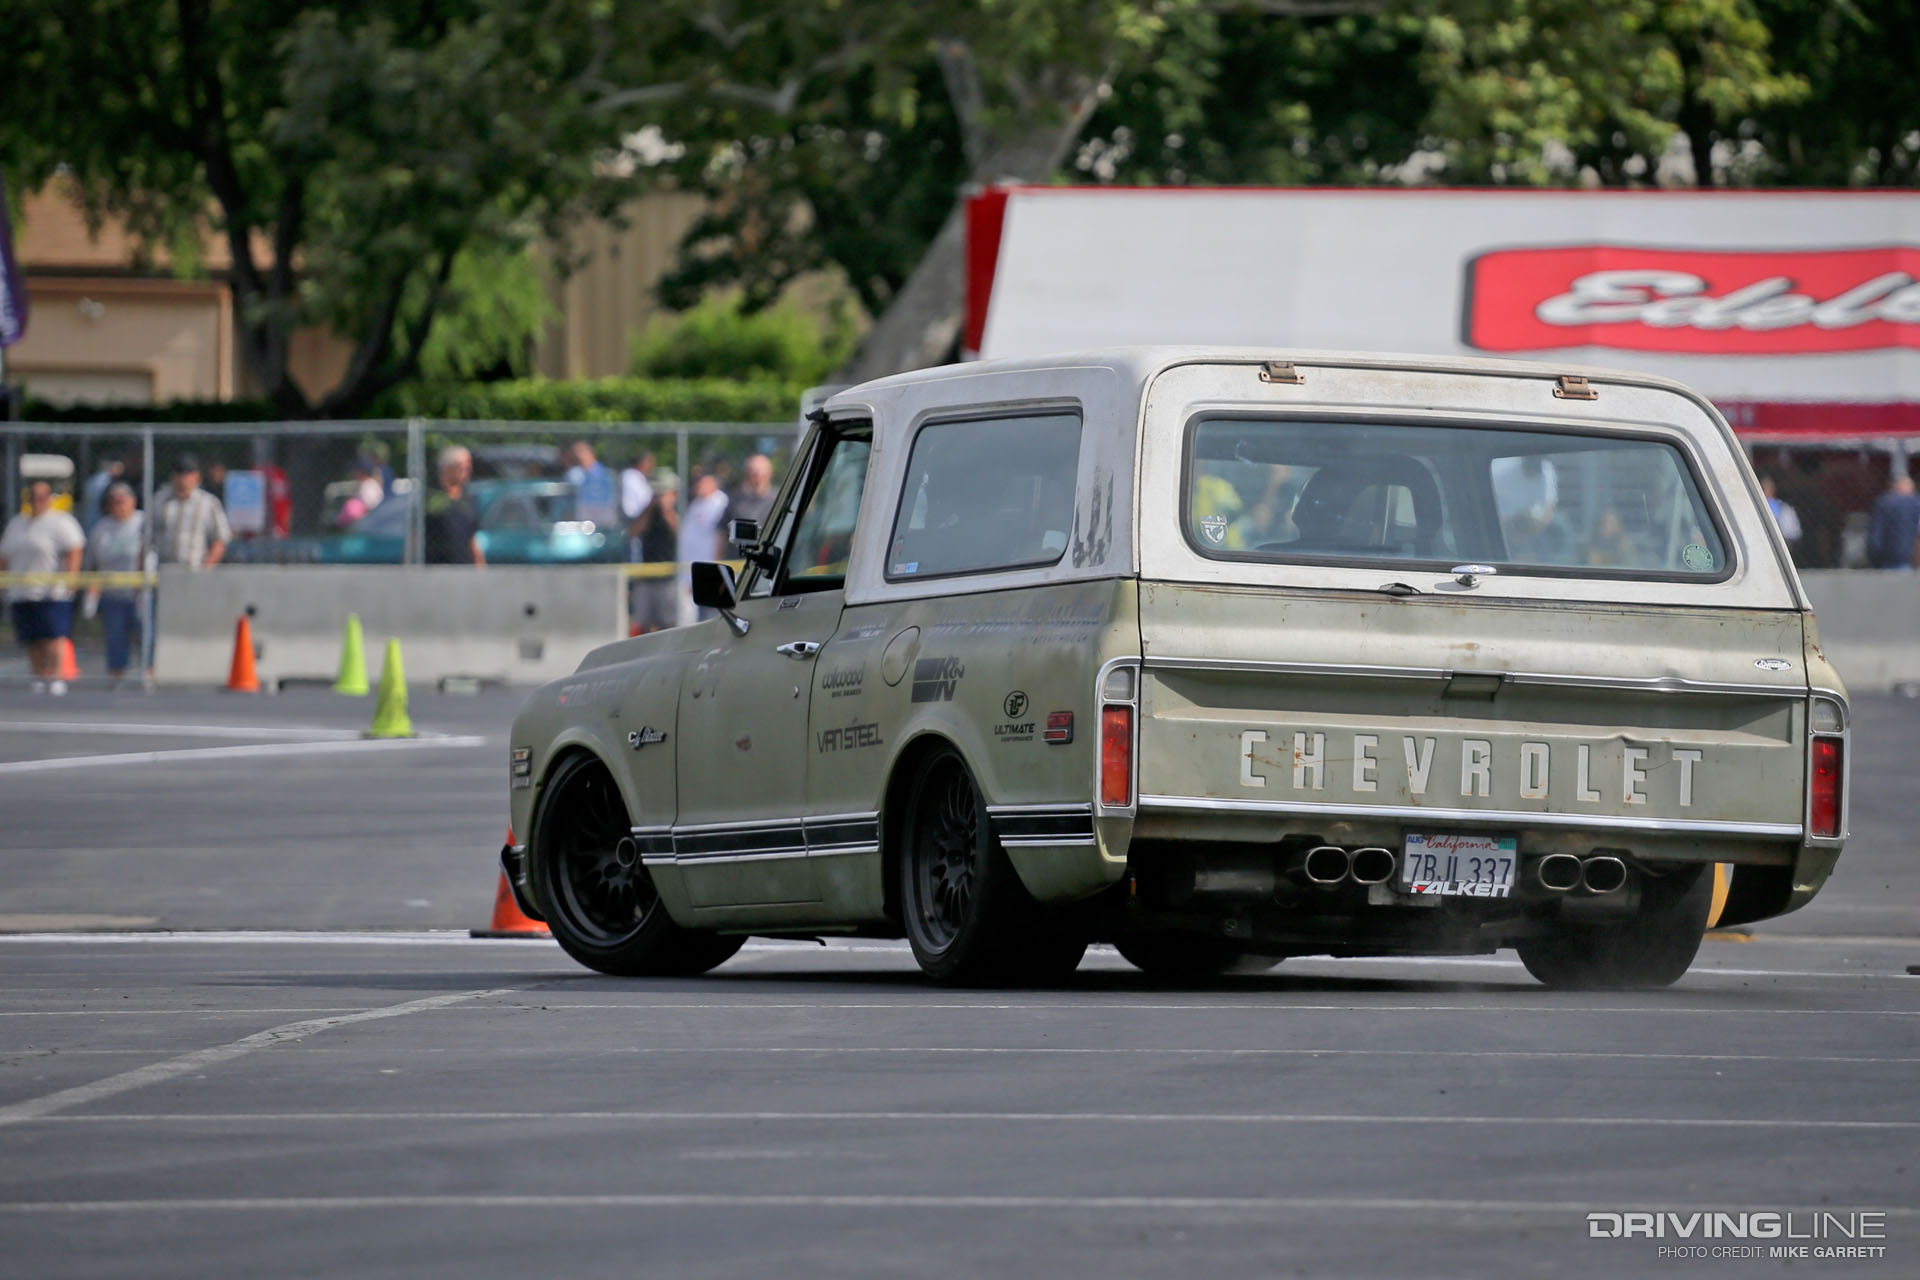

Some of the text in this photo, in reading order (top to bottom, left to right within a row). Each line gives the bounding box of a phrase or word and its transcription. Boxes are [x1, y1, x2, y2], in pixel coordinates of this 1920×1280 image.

[995, 723, 1036, 735] ULTIMATE
[1240, 730, 1703, 806] CHEVROLET
[1426, 834, 1500, 854] California
[1409, 880, 1510, 898] FALKEN
